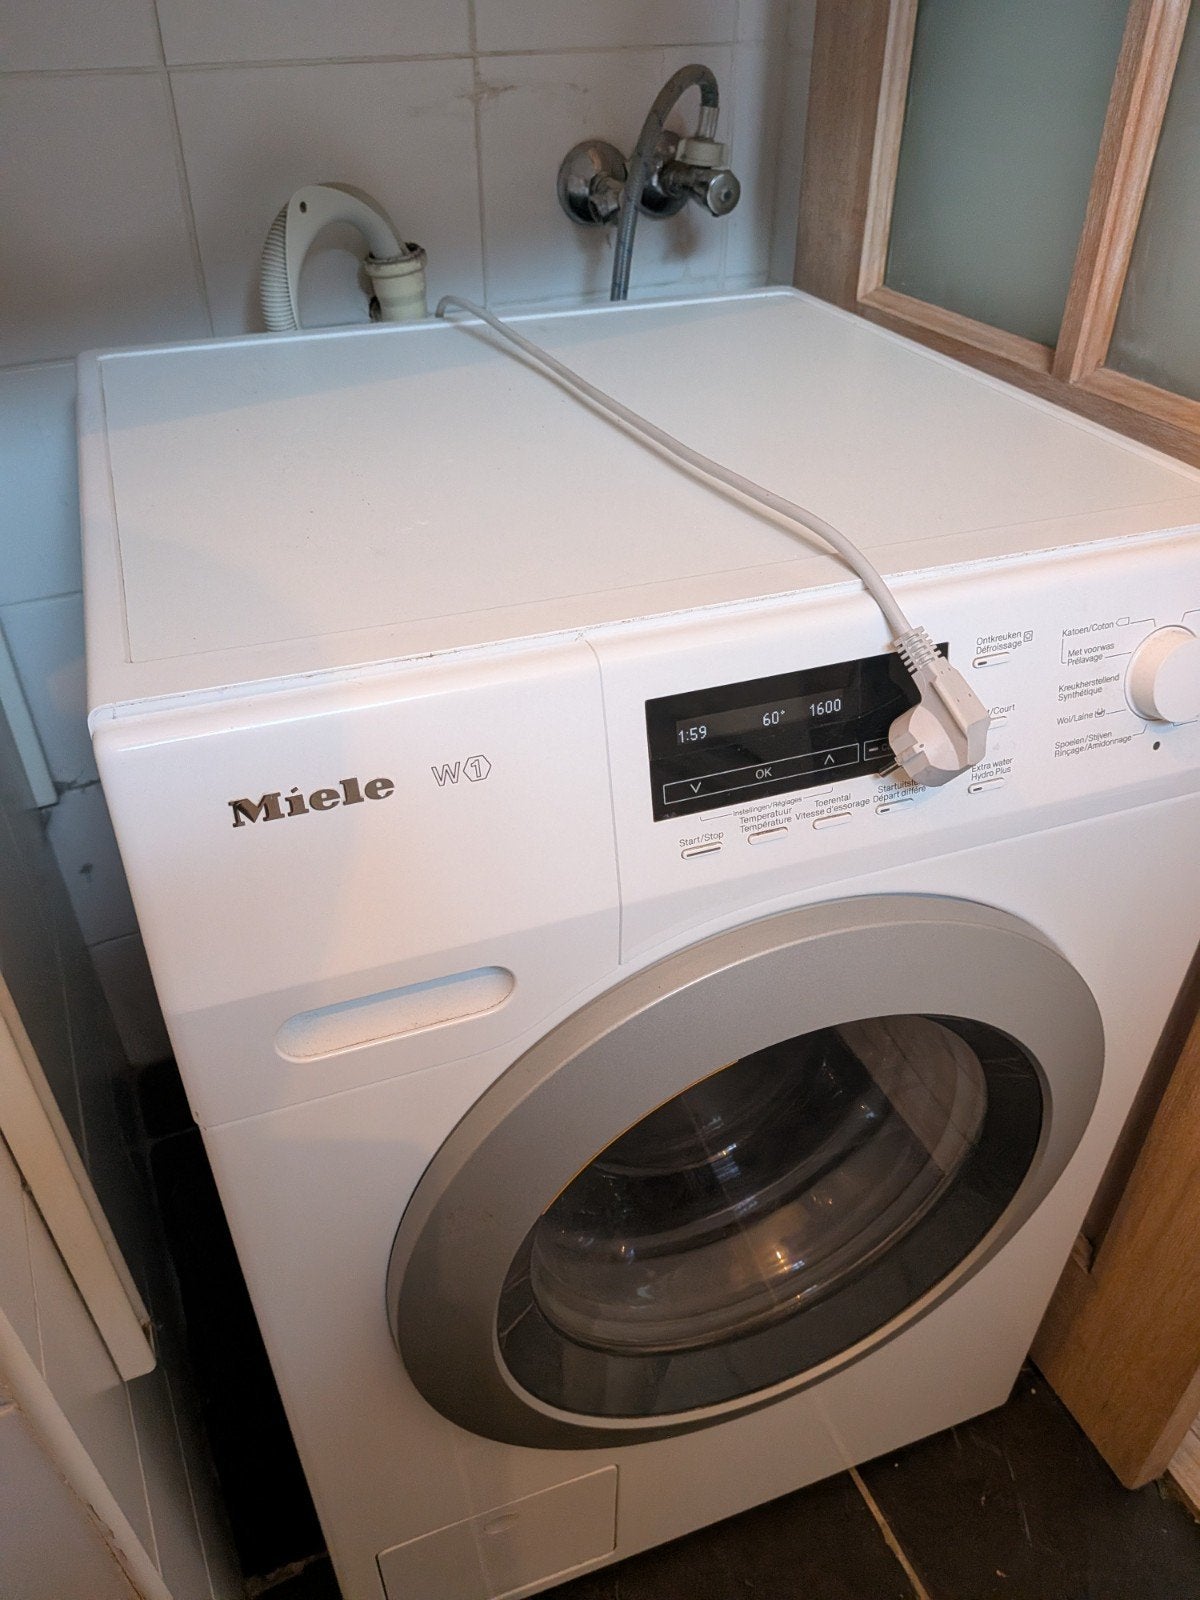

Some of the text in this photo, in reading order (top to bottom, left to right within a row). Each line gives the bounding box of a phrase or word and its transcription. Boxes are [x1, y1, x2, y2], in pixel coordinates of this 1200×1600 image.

[1061, 621, 1114, 637] Katoen/Coton
[976, 631, 1022, 646] Ontkreuken
[976, 640, 1023, 655] Défroissage
[1067, 642, 1115, 657] Met voorwas
[1067, 653, 1103, 667] Prélavage
[1058, 673, 1120, 692] Kreukherstellend
[1058, 686, 1103, 702] Synthétique
[678, 725, 707, 743] 1:59
[809, 698, 842, 717] 1600
[1056, 711, 1094, 725] Wol/Laine
[1054, 731, 1113, 750] Spoelen/Stijven
[1054, 735, 1132, 757] Rinçage/Amidonnage
[971, 757, 1014, 772] Extra water
[755, 766, 773, 780] OK
[971, 766, 1012, 781] Hydro Plus
[877, 779, 919, 794] Startuitste
[228, 777, 395, 828] Miele
[814, 793, 851, 807] Toerental
[873, 791, 900, 803] Départ
[740, 807, 793, 824] Temperatuur
[795, 798, 870, 821] Vitesse d'essorage
[740, 817, 792, 833] Température
[679, 831, 724, 848] Start/Stop
